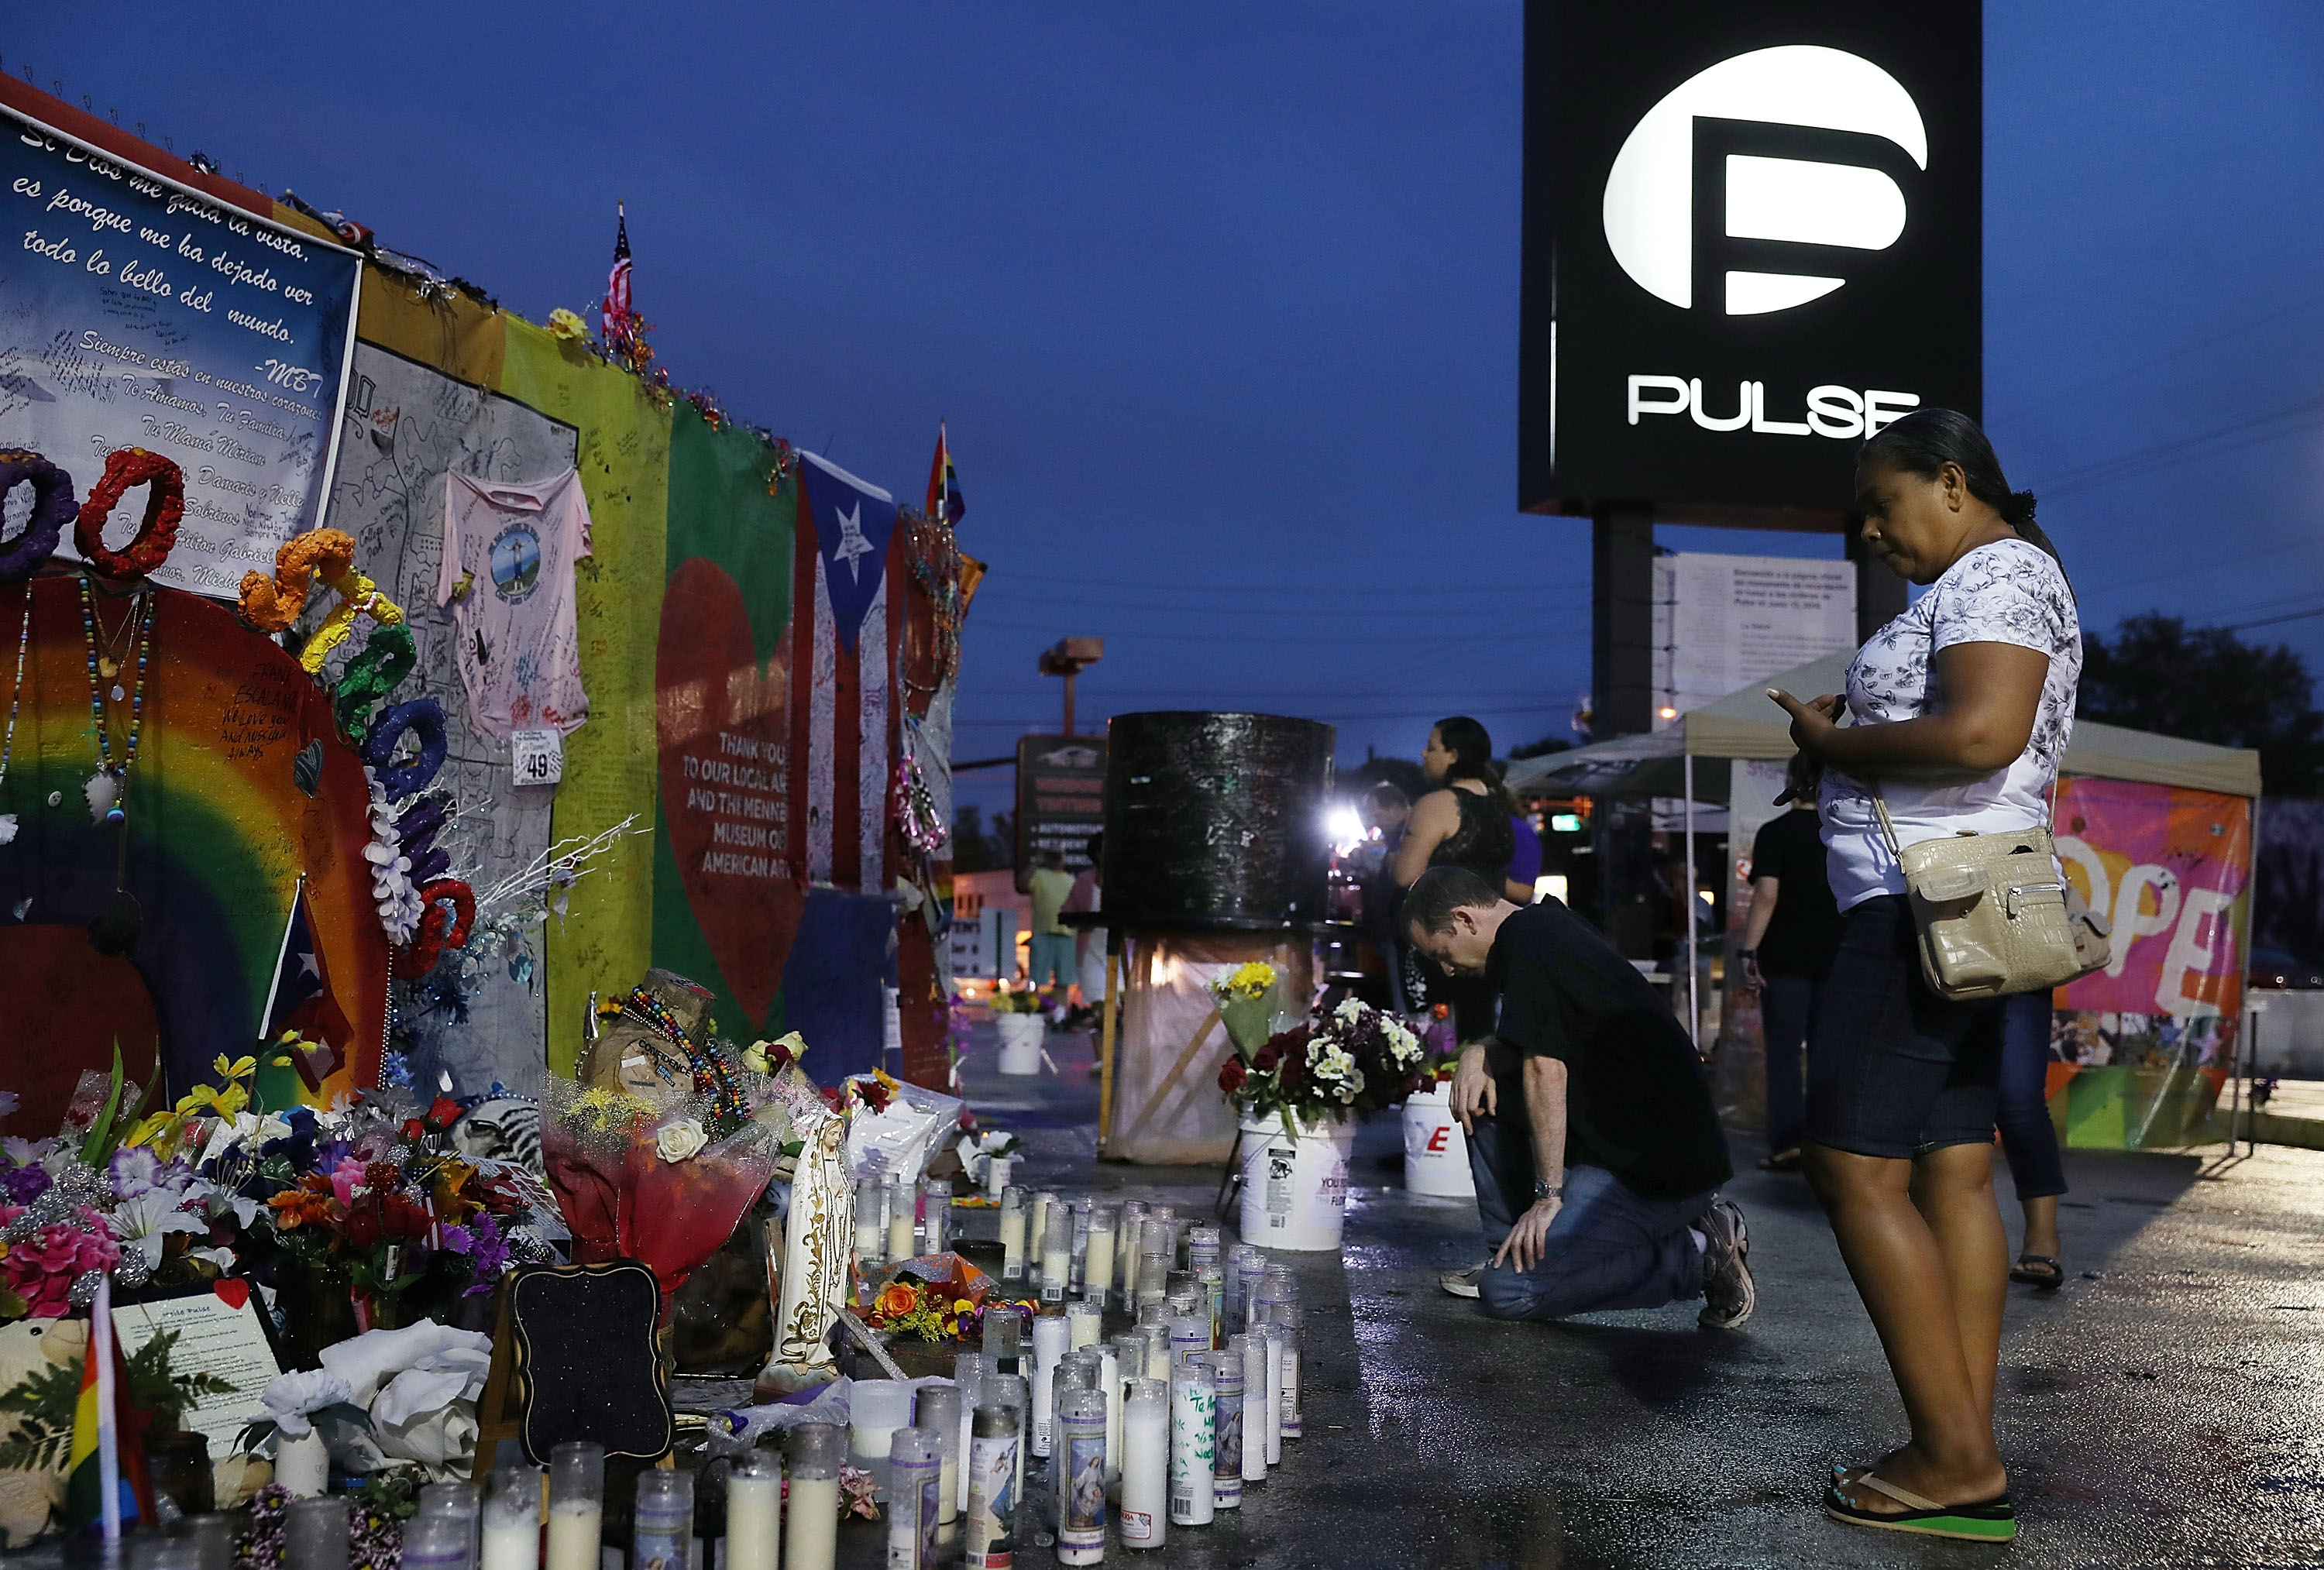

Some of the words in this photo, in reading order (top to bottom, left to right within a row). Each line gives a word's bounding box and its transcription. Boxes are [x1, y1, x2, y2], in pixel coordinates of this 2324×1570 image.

[129, 173, 163, 198] me
[228, 212, 250, 237] la
[256, 228, 310, 263] vista.
[12, 176, 42, 198] es
[46, 188, 133, 232] porque
[139, 225, 171, 249] me
[177, 233, 205, 263] ha
[211, 253, 279, 294] dejado
[284, 283, 315, 307] ver
[23, 229, 78, 265] todo
[86, 249, 112, 277] lo
[119, 259, 173, 298] bello
[179, 286, 213, 314] del
[226, 307, 297, 345] mundo.
[78, 329, 146, 366] Siempre
[194, 370, 213, 386] en
[216, 377, 269, 404] nuestros
[270, 394, 323, 421] corazones
[121, 375, 141, 397] Te
[144, 383, 209, 418] Amamos,
[215, 401, 235, 424] Tu
[1628, 374, 1920, 441] PULSE
[142, 415, 162, 438] Tu
[163, 421, 218, 452] Mamá
[218, 436, 267, 468] Miriam
[198, 465, 258, 497] Damaris
[258, 487, 268, 505] y
[269, 483, 305, 515] Nelly
[182, 496, 242, 527] Sobrinos
[118, 512, 138, 535] Tu
[219, 535, 275, 565] Gabriel
[253, 662, 297, 688] FRANK
[719, 732, 758, 760] THANK
[528, 754, 548, 778] 49
[682, 755, 699, 778] TO
[701, 758, 731, 785] OUR
[732, 764, 770, 791] LOCAL
[687, 787, 717, 812] AND
[713, 821, 767, 850] MUSEUM
[702, 851, 768, 878] AMERICAN
[638, 1039, 693, 1078] CONFIDENCE
[665, 1075, 676, 1087] WAY
